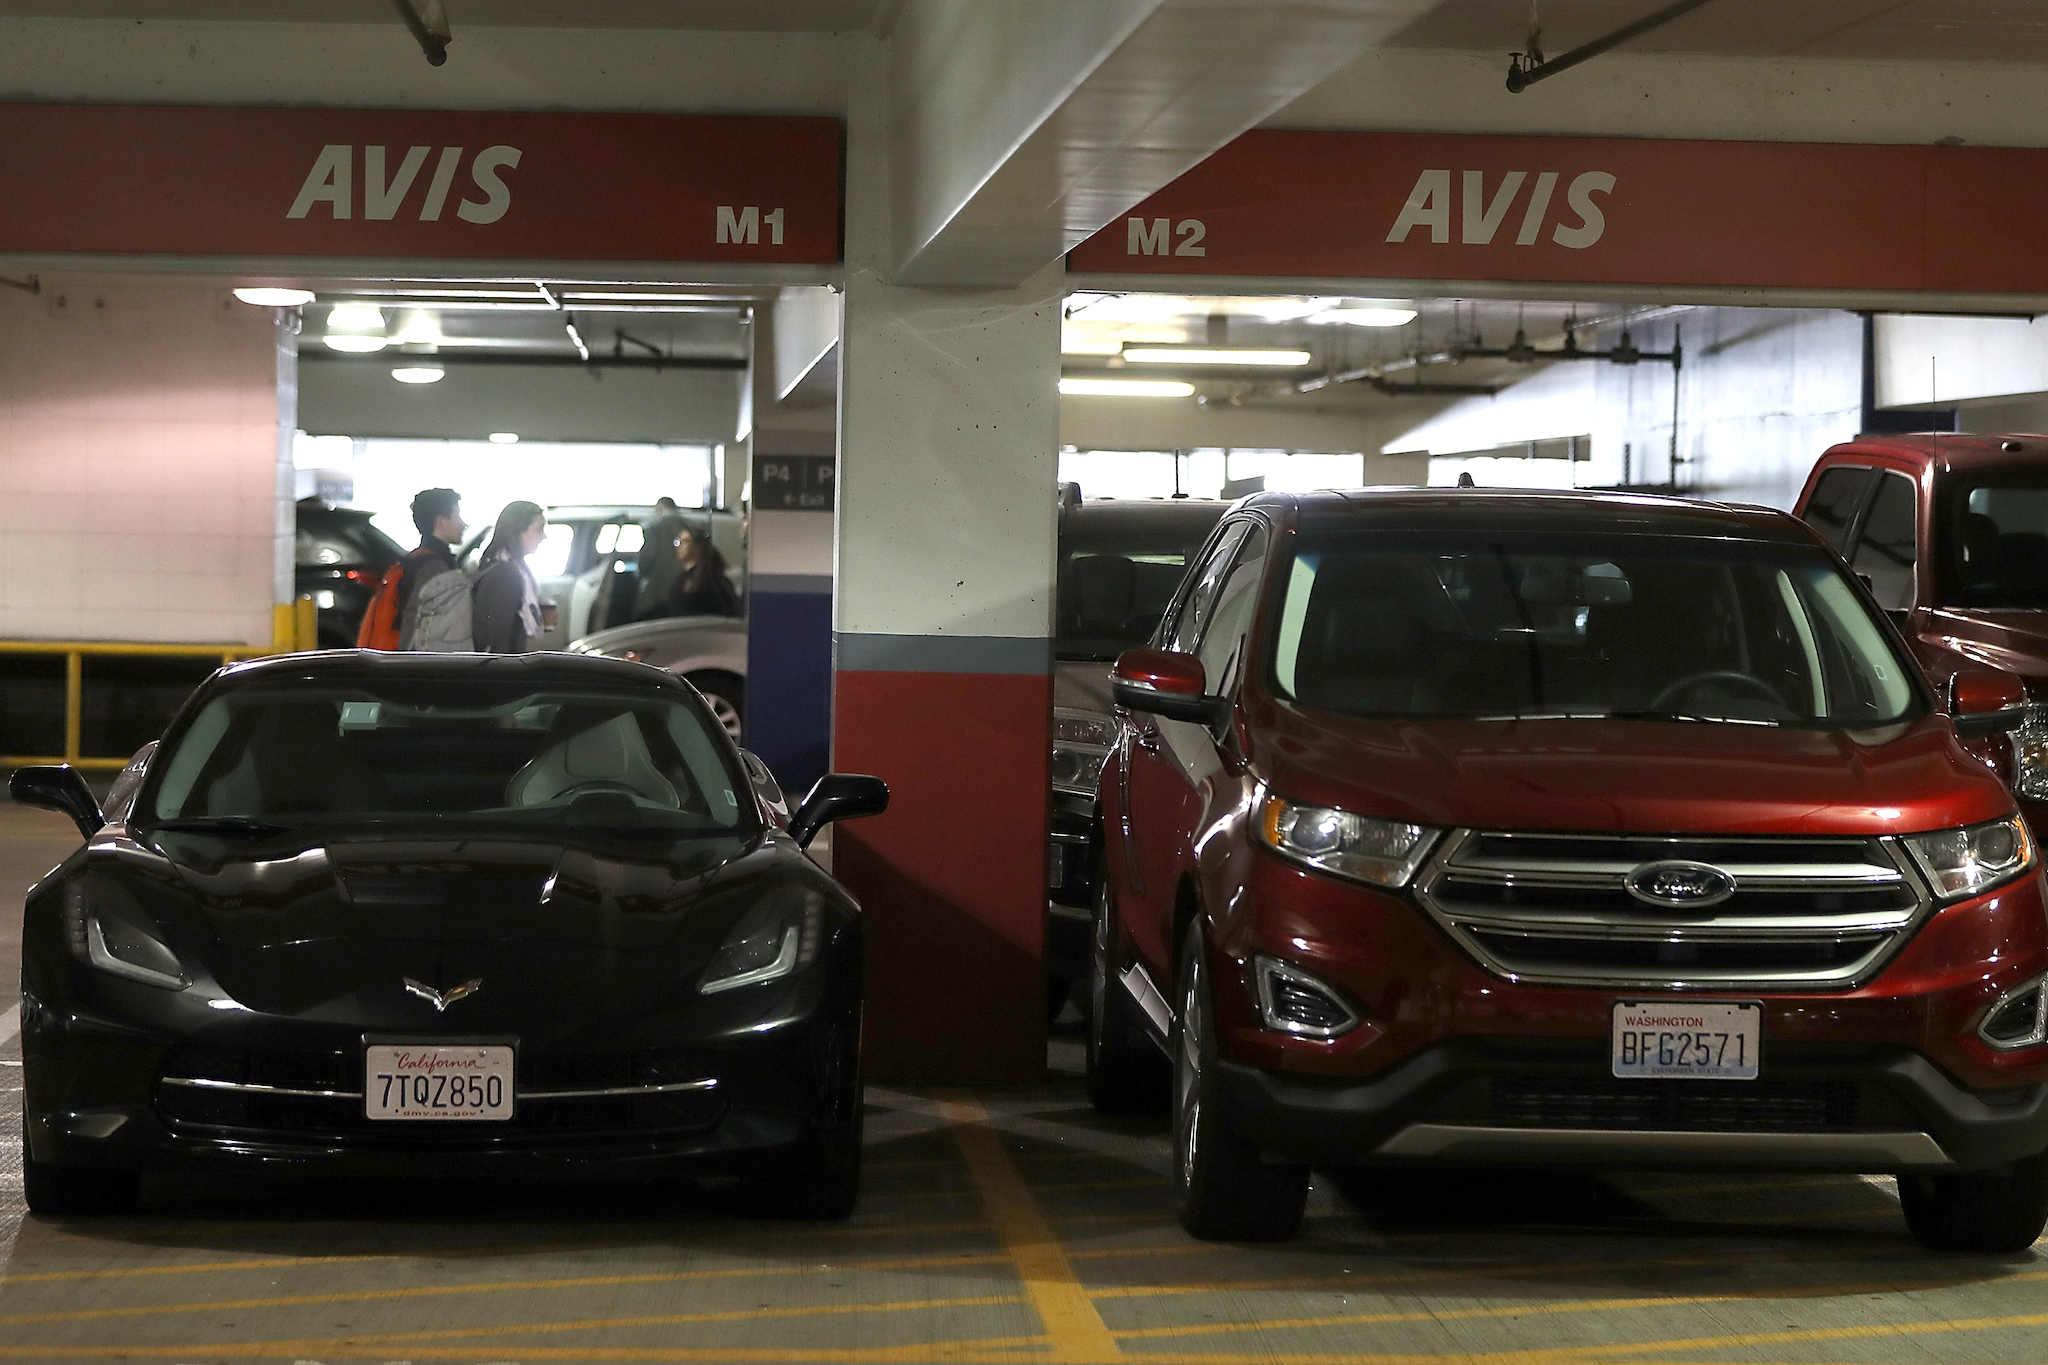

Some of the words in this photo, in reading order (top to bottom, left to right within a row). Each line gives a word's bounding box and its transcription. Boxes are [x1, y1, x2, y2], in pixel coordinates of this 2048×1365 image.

[287, 144, 523, 225] AVIS
[716, 205, 785, 246] M1
[1386, 169, 1617, 249] AVIS
[1126, 217, 1206, 258] M2
[763, 463, 790, 483] P4
[818, 464, 834, 483] P
[1653, 870, 1715, 895] Ford
[1625, 1016, 1704, 1027] WASHINGTON
[398, 1052, 486, 1074] California
[1622, 1031, 1745, 1067] BFG2571
[377, 1075, 502, 1108] 7TQZ850
[403, 1109, 477, 1118] dmv.ca.gov
